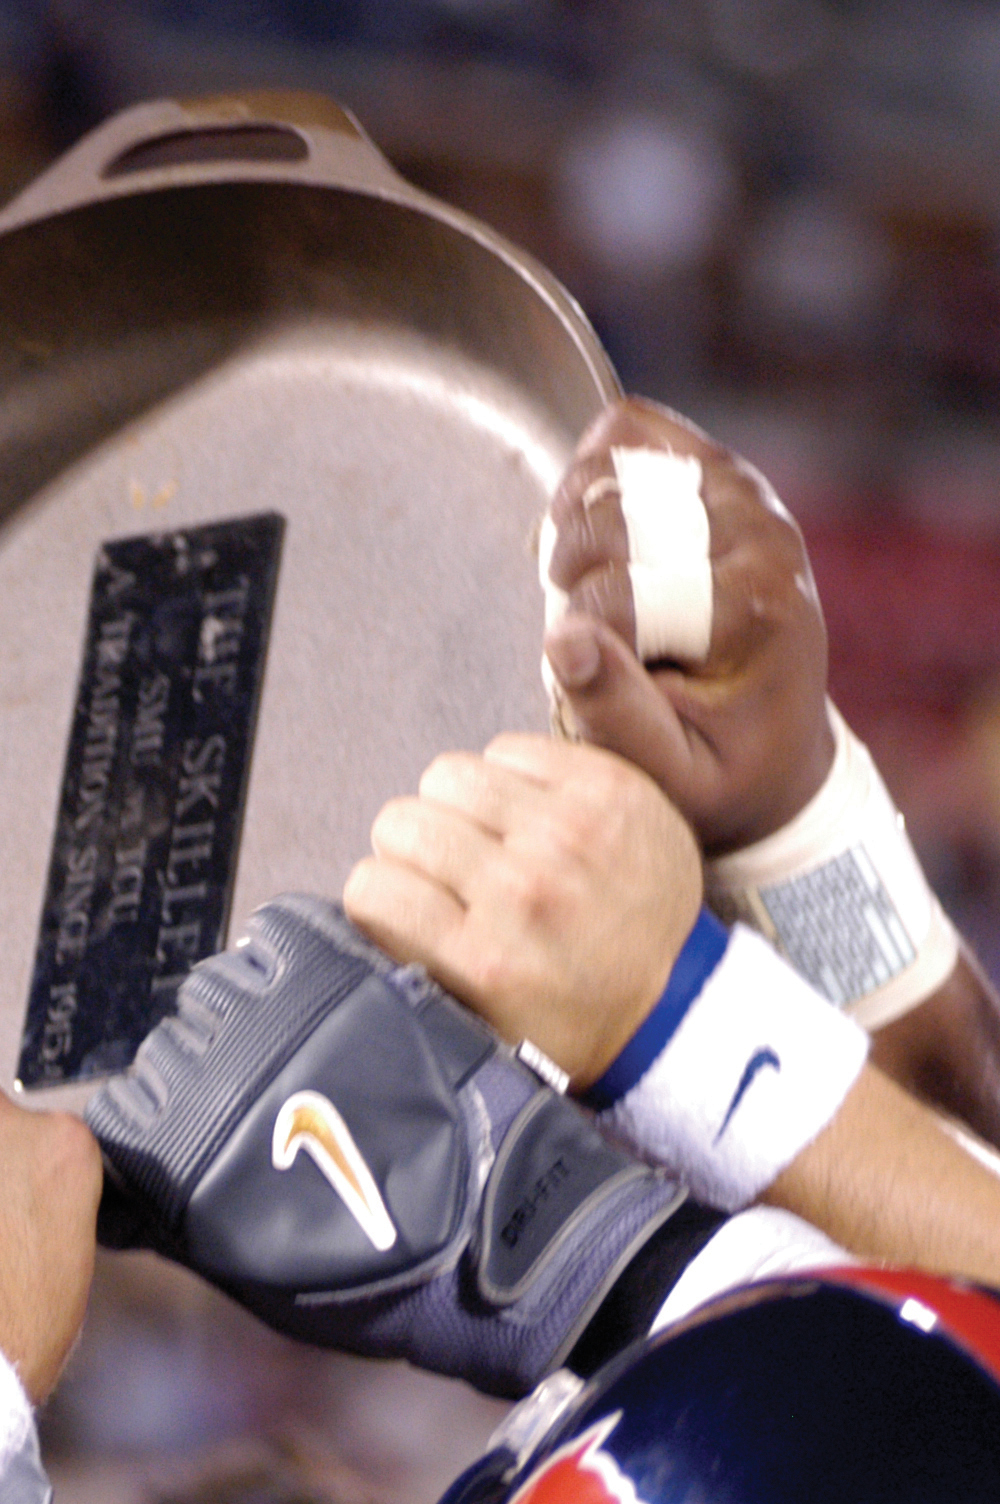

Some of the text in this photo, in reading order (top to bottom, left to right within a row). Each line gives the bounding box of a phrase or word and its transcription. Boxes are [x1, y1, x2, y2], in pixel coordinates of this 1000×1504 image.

[102, 556, 137, 598] A
[74, 611, 139, 831] TRADITION
[130, 672, 172, 768] SMU
[150, 573, 250, 999] THE SKILLET
[55, 845, 98, 966] SINCE
[107, 838, 148, 925] TCU
